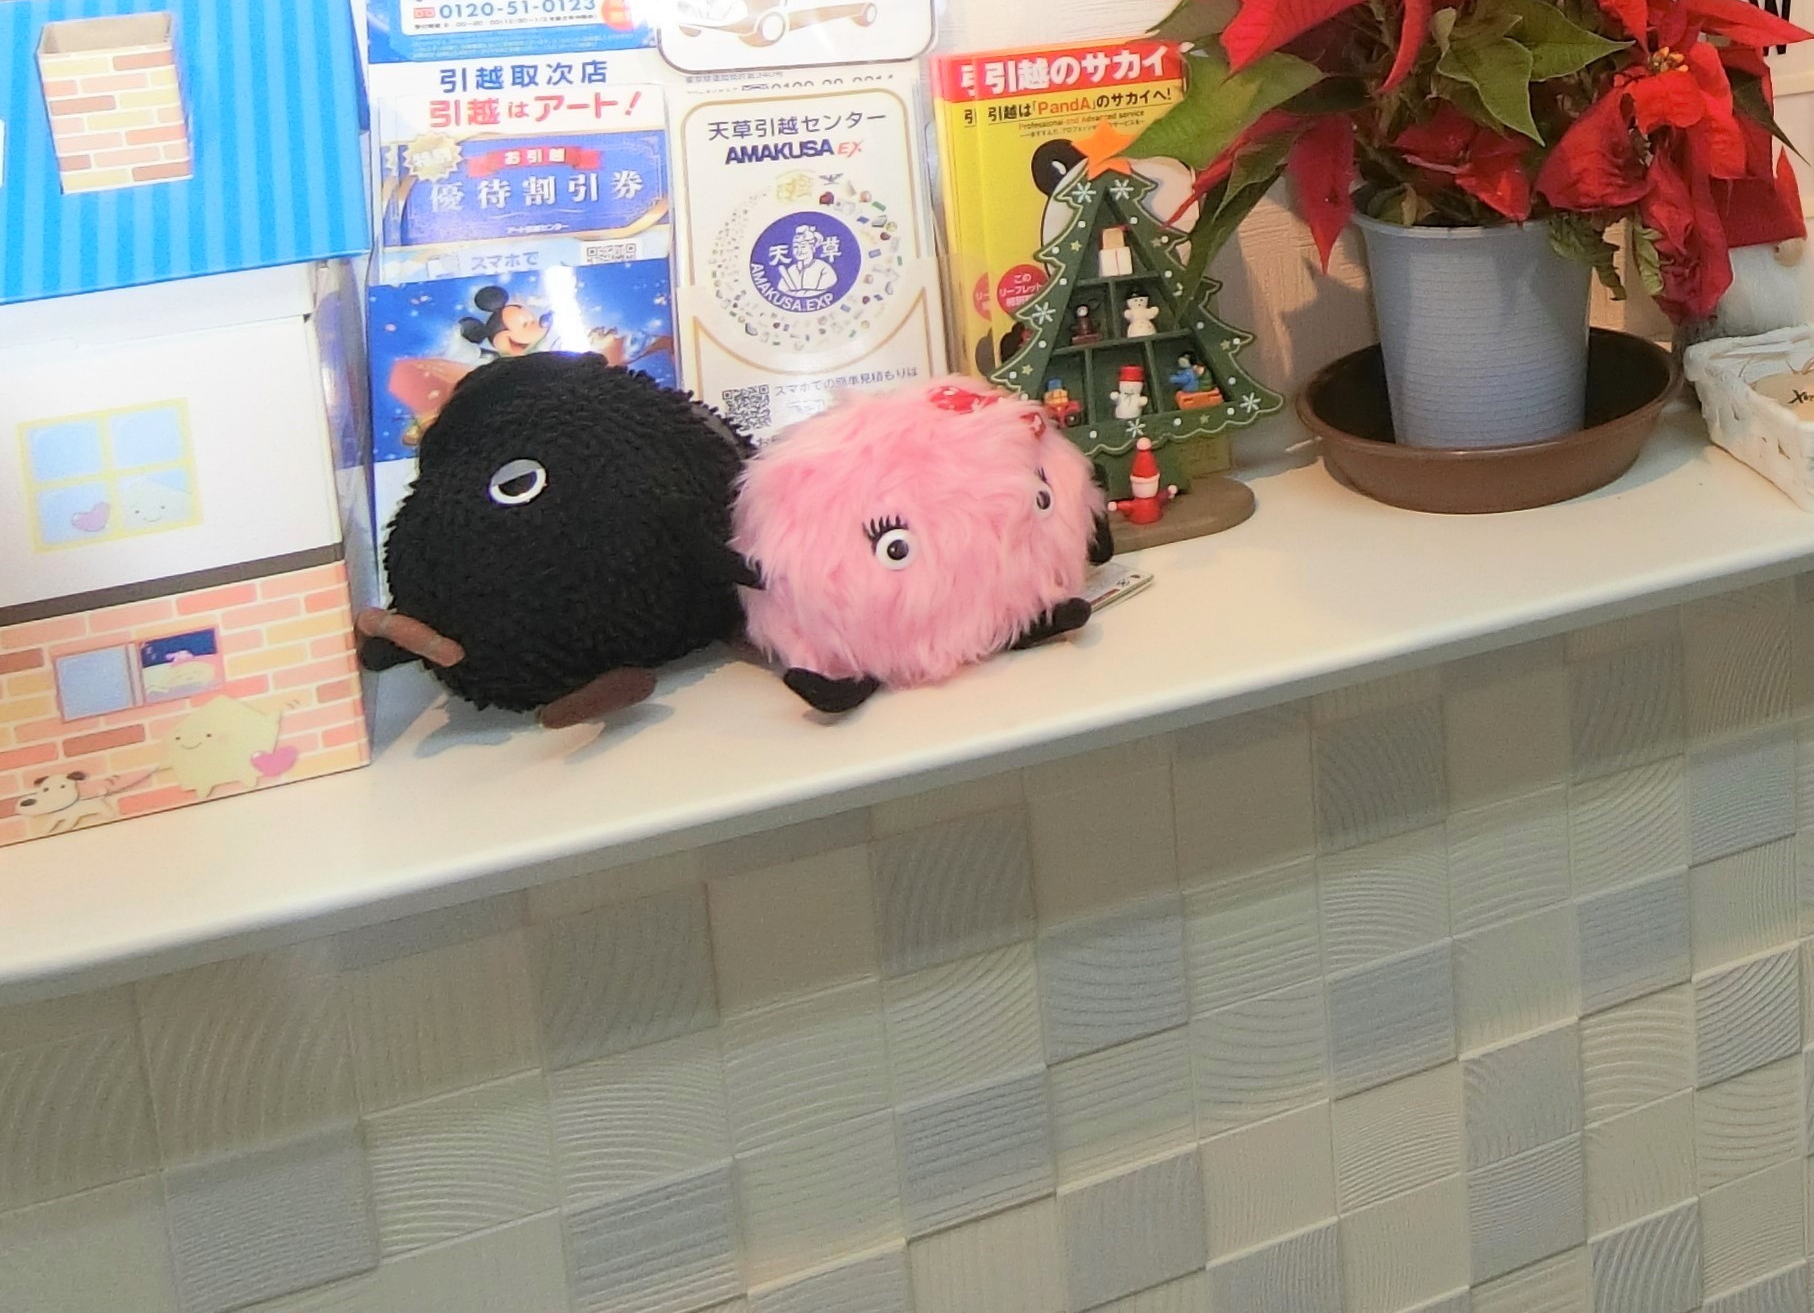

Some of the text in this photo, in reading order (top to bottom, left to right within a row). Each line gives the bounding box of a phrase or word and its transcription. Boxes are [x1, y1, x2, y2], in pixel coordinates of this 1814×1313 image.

[439, 60, 608, 93] 引越取次店
[984, 45, 1169, 95] 引越のサカイ
[429, 91, 642, 128] 引越はアート!
[707, 111, 887, 141] 天草引越センター
[725, 138, 835, 165] AMAKUSA
[430, 169, 645, 213] 優待割引券
